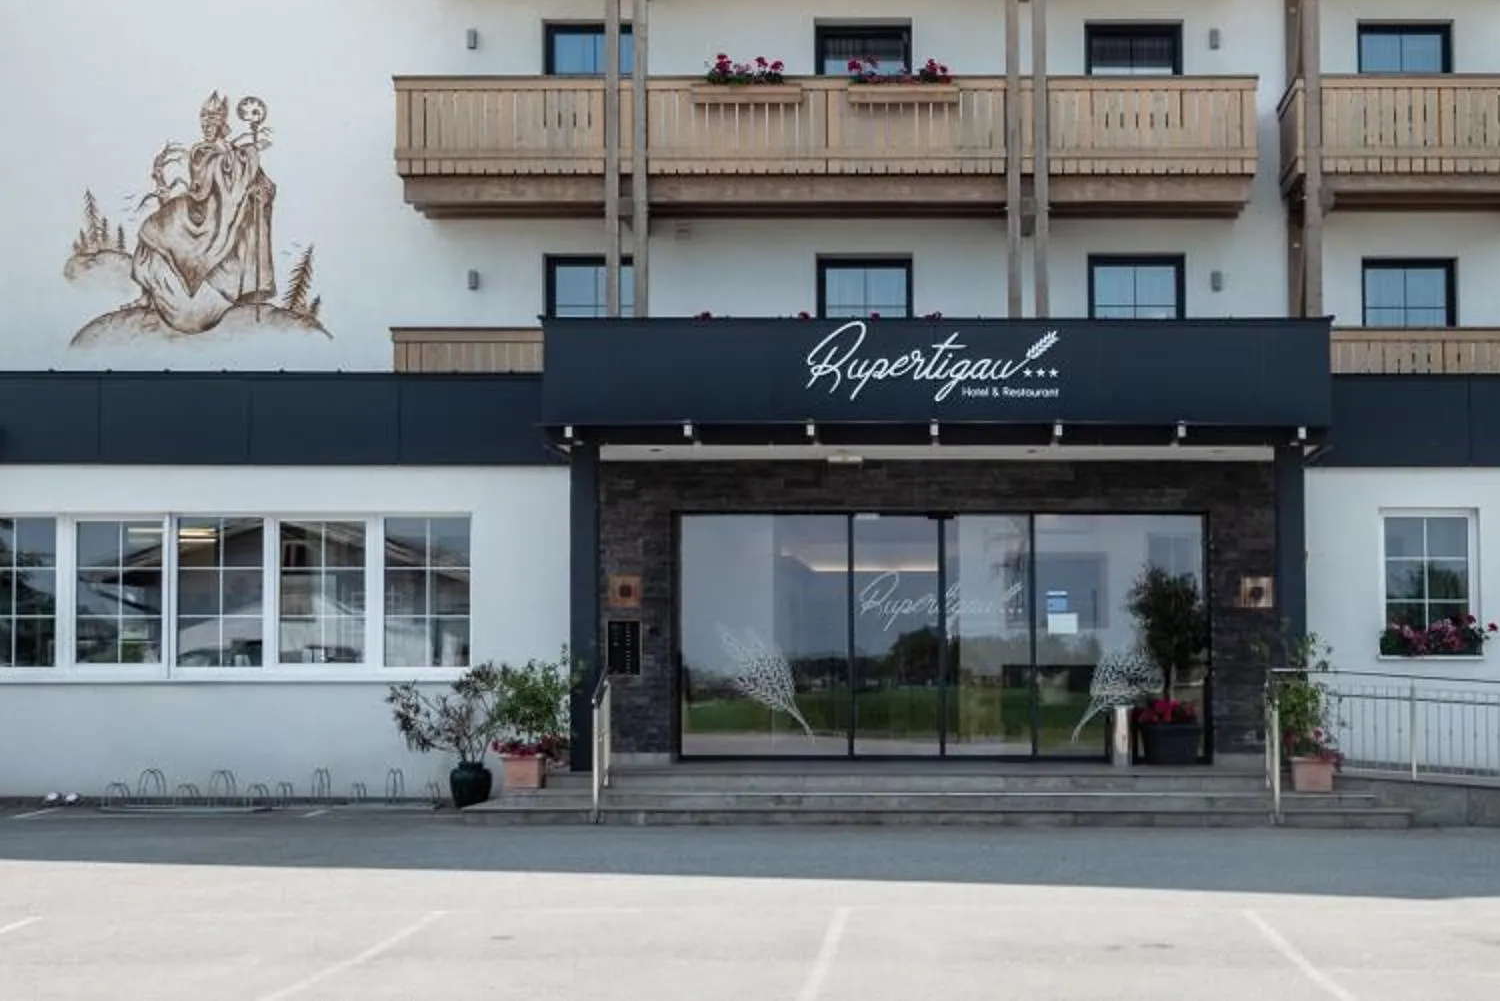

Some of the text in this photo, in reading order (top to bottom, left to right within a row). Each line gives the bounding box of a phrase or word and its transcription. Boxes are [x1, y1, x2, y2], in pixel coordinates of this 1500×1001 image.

[806, 320, 1020, 402] Rupertigau
[961, 386, 1060, 398] Hotel & Restaurant
